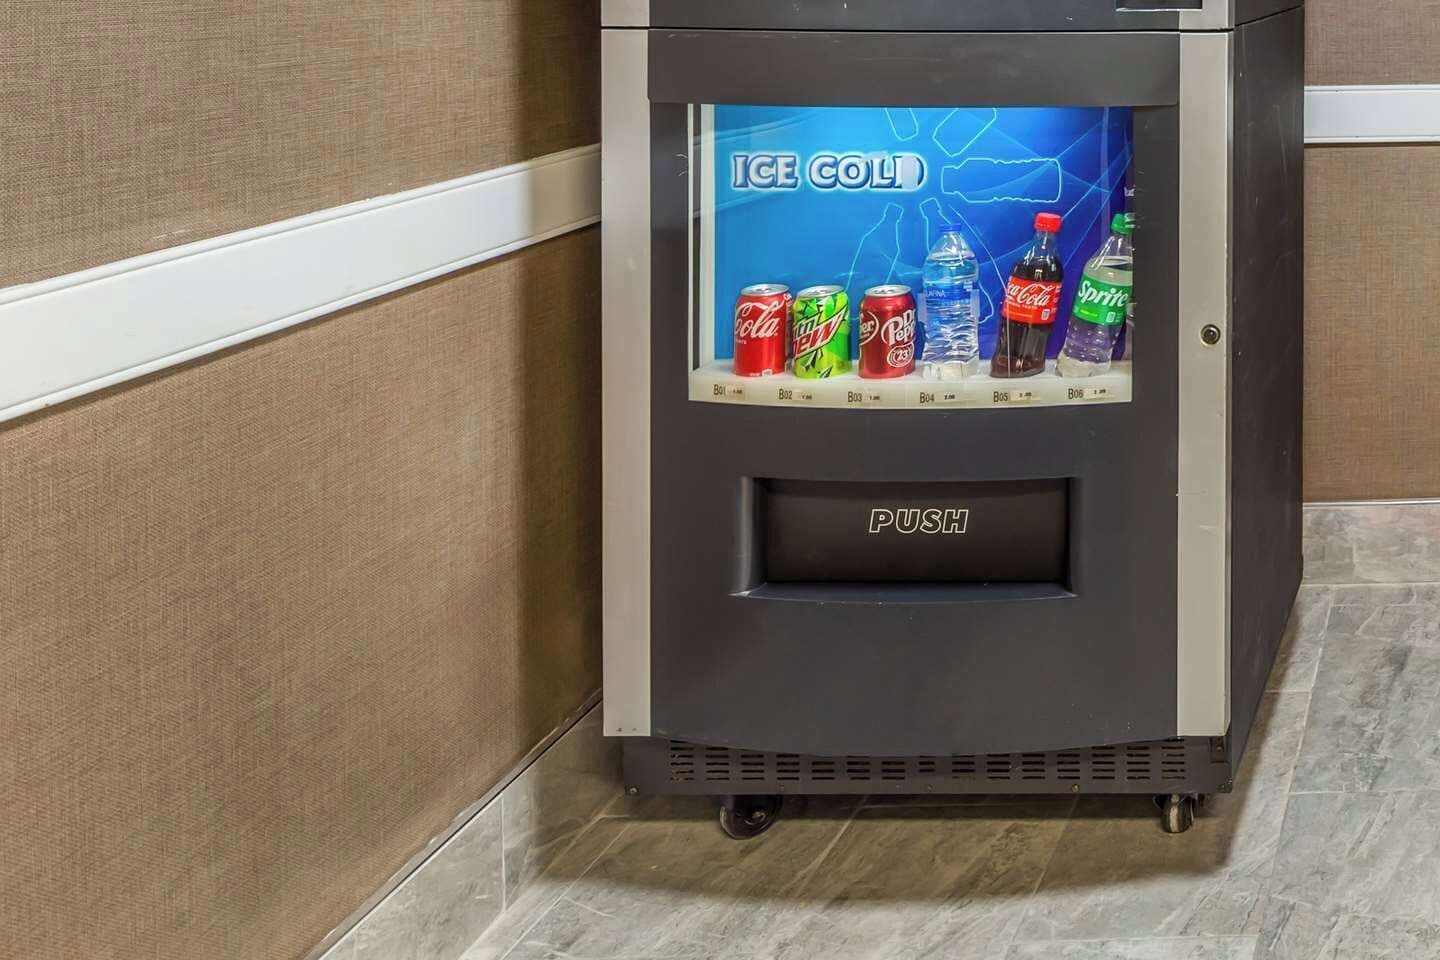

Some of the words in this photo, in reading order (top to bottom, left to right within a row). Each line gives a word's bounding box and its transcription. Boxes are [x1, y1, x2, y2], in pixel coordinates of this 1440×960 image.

[734, 154, 798, 189] ICE
[1078, 281, 1129, 307] Sprite
[896, 350, 908, 361] 23
[779, 388, 792, 400] B02
[848, 391, 862, 403] B03
[920, 392, 934, 403] B04
[993, 392, 1008, 403] B05
[1068, 388, 1083, 400] B06
[869, 508, 969, 534] PUSH
